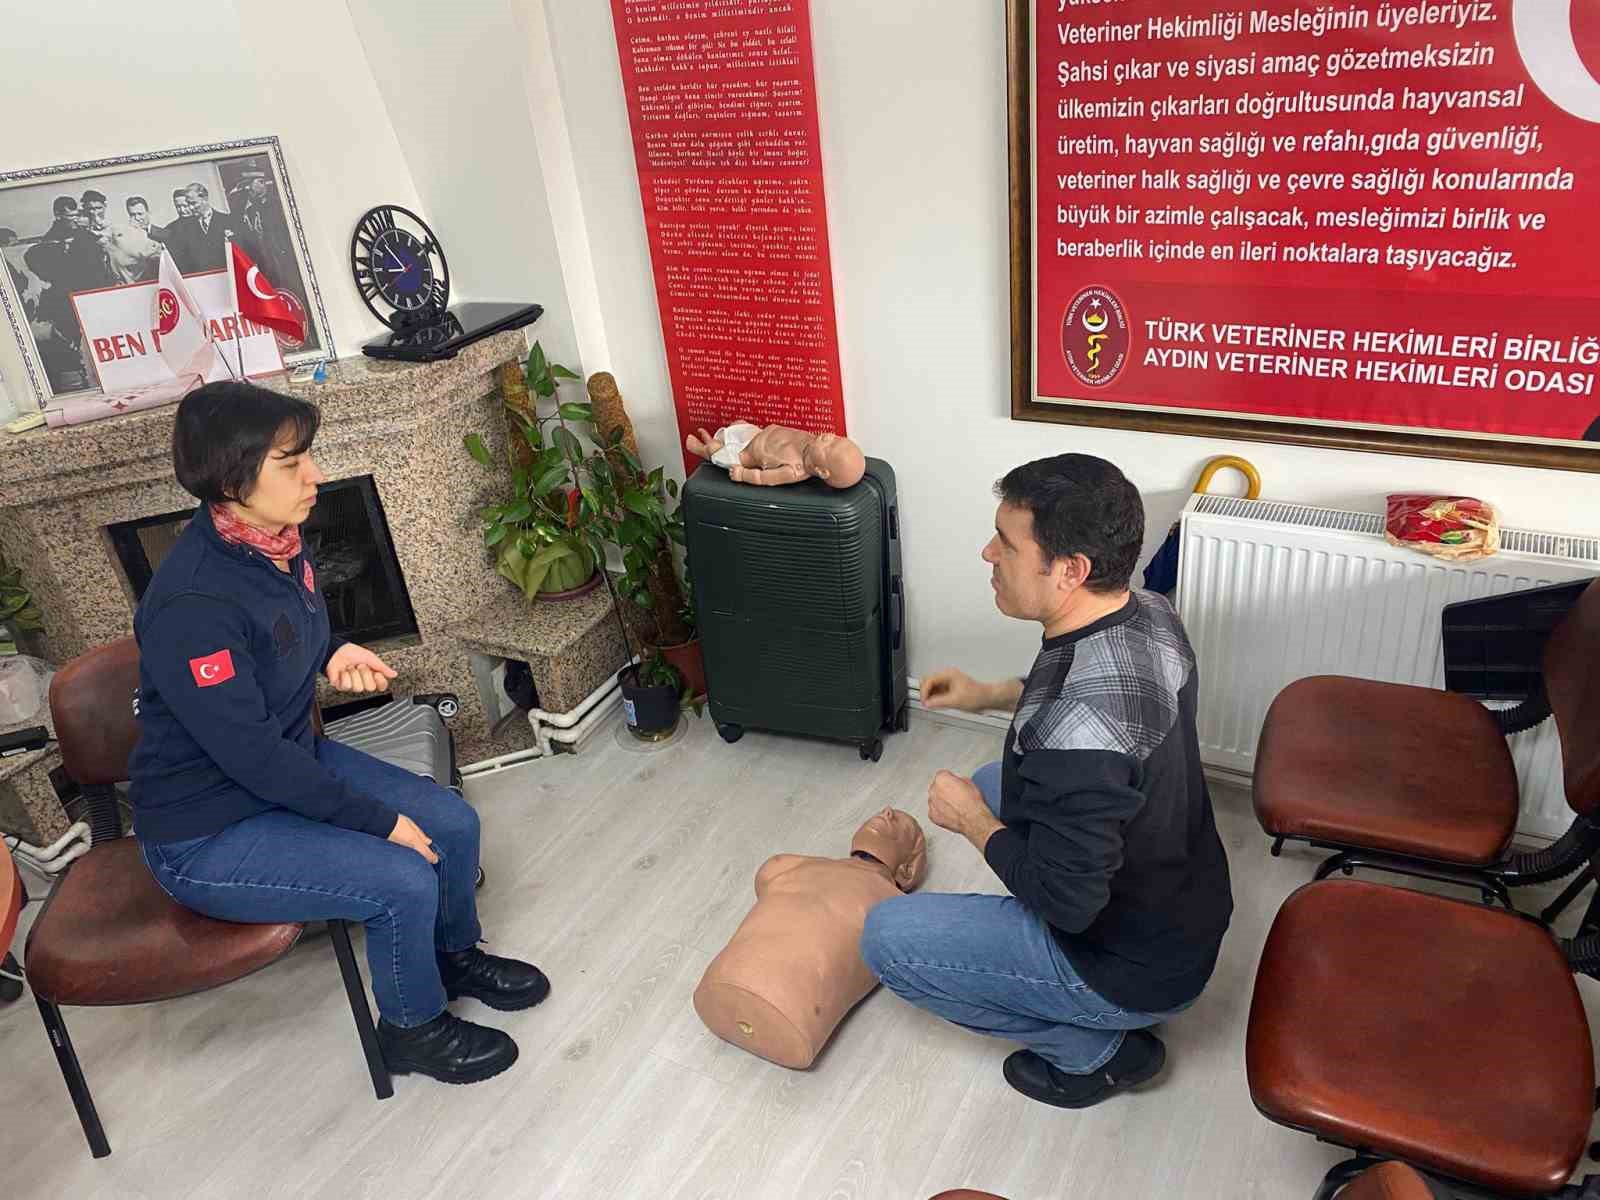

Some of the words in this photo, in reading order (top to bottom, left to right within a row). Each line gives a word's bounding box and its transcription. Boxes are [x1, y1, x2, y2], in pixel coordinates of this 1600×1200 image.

[1057, 20, 1143, 45] Veteriner
[1147, 11, 1243, 41] Hekimliği
[1249, 4, 1369, 37] Mesleğinin
[1376, 0, 1497, 33] üyeleriyiz.
[1057, 59, 1108, 88] Şahsi
[1113, 58, 1162, 86] çıkar
[1166, 60, 1190, 78] ve
[1195, 51, 1256, 82] siyasi
[1261, 54, 1321, 78] amaç
[1326, 41, 1495, 77] gözetmeksizin
[1057, 96, 1144, 119] ülkemizin
[1150, 93, 1229, 122] çıkarları
[1235, 87, 1395, 120] doğrultusunda
[1401, 83, 1525, 115] hayvansal
[1057, 134, 1119, 158] üretim,
[1125, 133, 1193, 159] hayvan
[1199, 130, 1266, 158] sağlığı
[1271, 135, 1297, 152] ve
[1426, 125, 1543, 156] güvenliği,
[1057, 169, 1137, 190] veteriner
[1141, 169, 1181, 190] halk
[1186, 169, 1251, 195] sağlığı
[1257, 173, 1281, 190] ve
[1287, 173, 1345, 195] çevre
[1351, 167, 1425, 196] sağlığı
[1431, 166, 1574, 190] konularında
[1057, 204, 1110, 229] büyük
[1115, 204, 1141, 224] bir
[1144, 205, 1205, 226] azimle
[1210, 206, 1309, 231] çalışacak,
[1315, 206, 1447, 233] mesleğimizi
[1452, 207, 1512, 230] birlik
[1518, 213, 1546, 230] ve
[1057, 238, 1144, 258] beraberlik
[1149, 239, 1205, 263] içinde
[1210, 245, 1234, 260] en
[1240, 240, 1277, 261] ileri
[1282, 241, 1380, 265] noktalara
[1386, 244, 1517, 273] taşıyacağız.
[92, 330, 146, 363] BEN
[203, 313, 271, 343] ARIM
[1144, 316, 1206, 343] TÜRK
[1211, 323, 1346, 351] VETERİNER
[1352, 329, 1498, 360] HEKİMLERİ
[1503, 333, 1600, 365] BİRLİĞ
[1143, 347, 1209, 370] AYDIN
[1215, 351, 1348, 379] VETERİNER
[1355, 358, 1499, 389] HEKİMLERİ
[1504, 369, 1595, 395] ODASI
